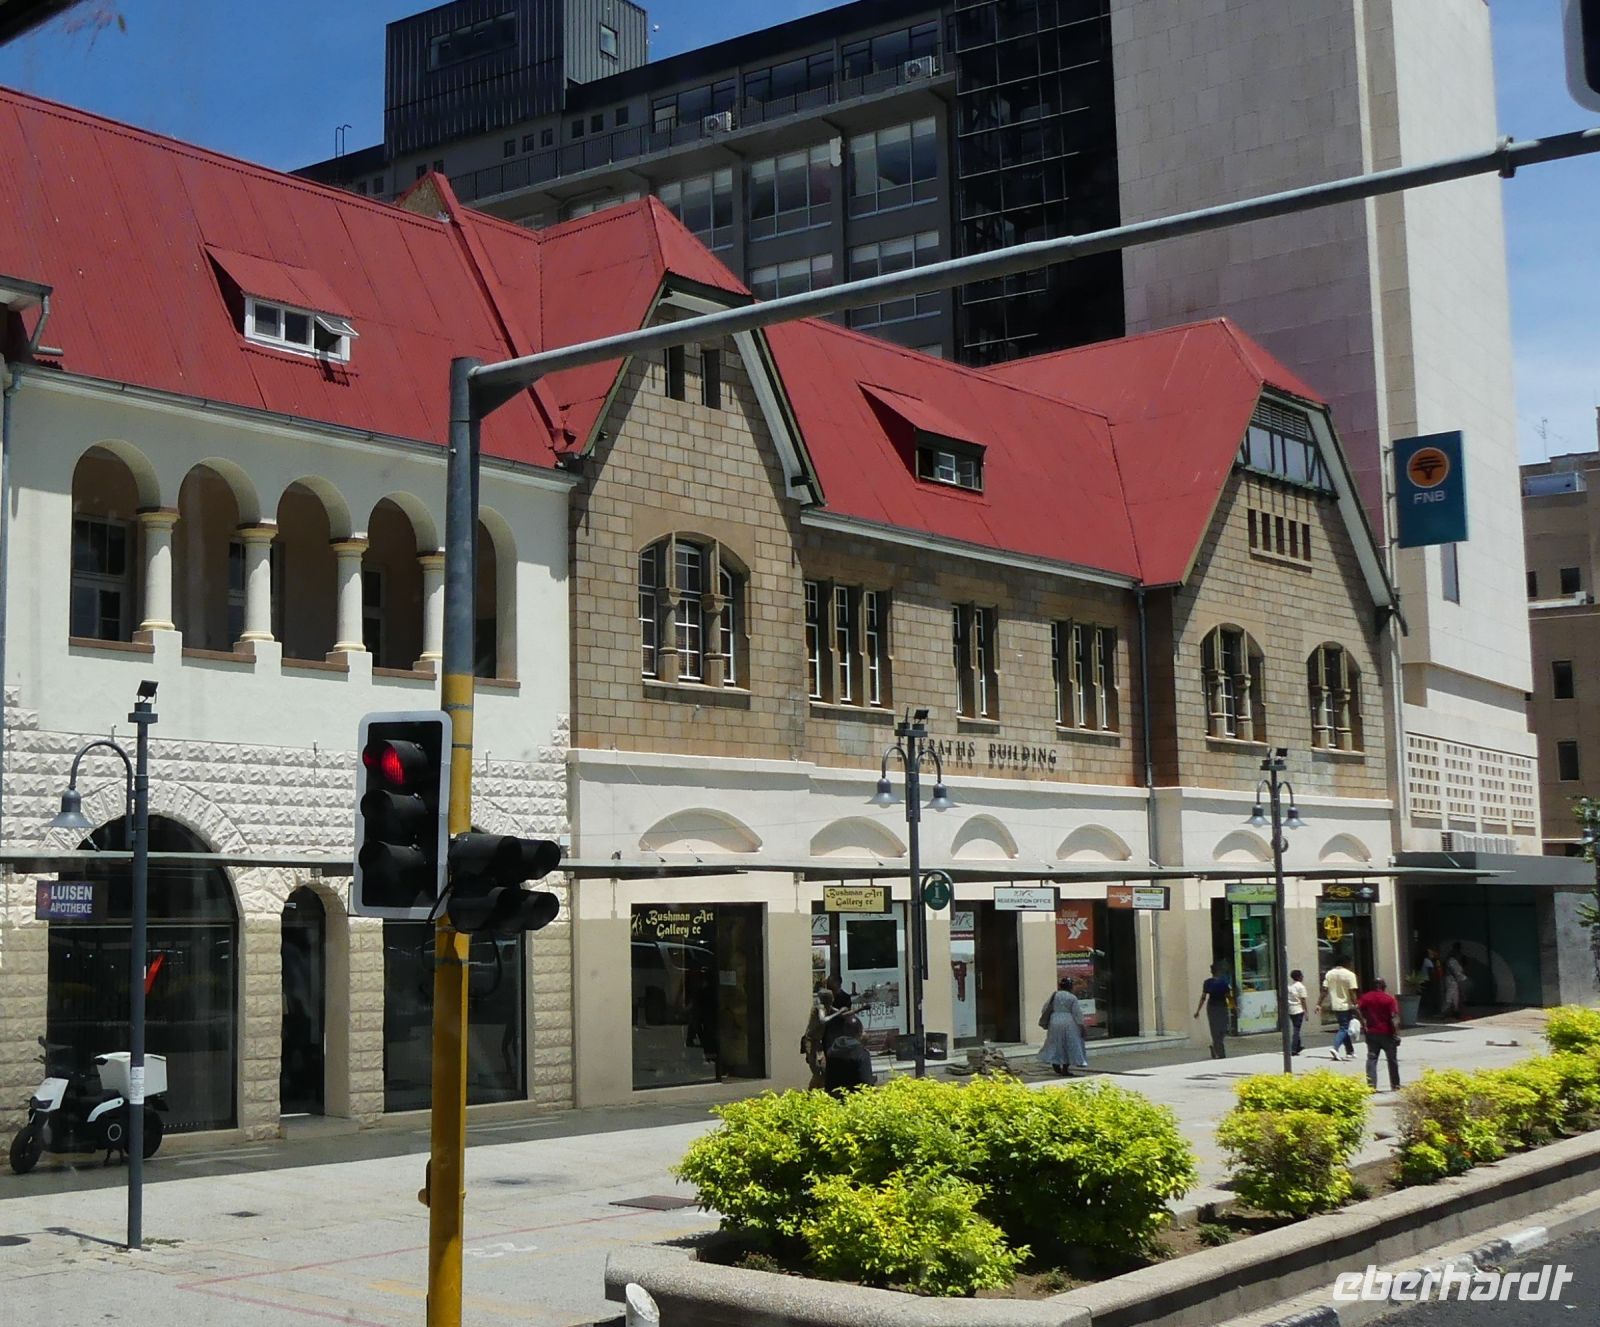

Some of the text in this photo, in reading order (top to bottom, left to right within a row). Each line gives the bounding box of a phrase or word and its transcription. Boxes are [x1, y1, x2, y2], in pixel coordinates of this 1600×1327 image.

[1413, 490, 1446, 504] FNB
[896, 735, 1057, 764] EKRATHS BUILDING
[51, 885, 93, 900] LUISEN
[826, 888, 883, 898] Bushman Art
[50, 902, 93, 913] APOTHEKE
[835, 898, 863, 907] Gallery
[646, 909, 714, 925] Bushman Art
[656, 923, 689, 938] Gallery
